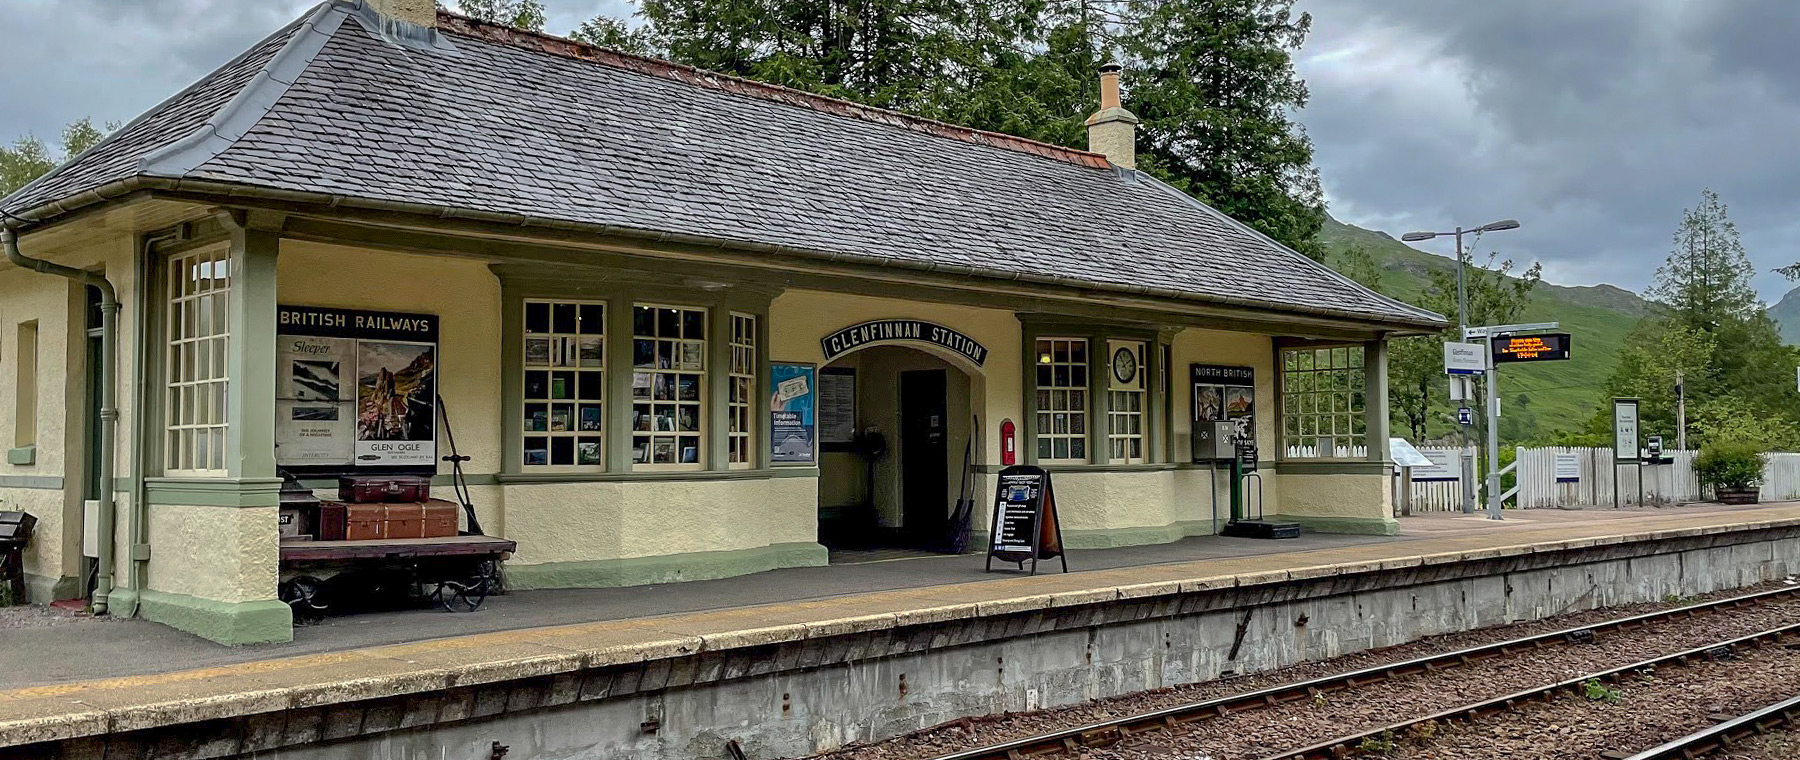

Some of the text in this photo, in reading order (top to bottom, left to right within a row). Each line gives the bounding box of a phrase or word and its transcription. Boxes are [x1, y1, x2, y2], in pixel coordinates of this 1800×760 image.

[280, 311, 429, 332] BRITISH RAILWAYS
[831, 322, 982, 361] GLENFINNAN STATION
[292, 341, 331, 355] Sleeper
[1195, 367, 1253, 378] NORTH BRITISH
[773, 412, 797, 420] Timetable
[371, 443, 421, 451] GLEN OGLE
[279, 516, 289, 524] ST
